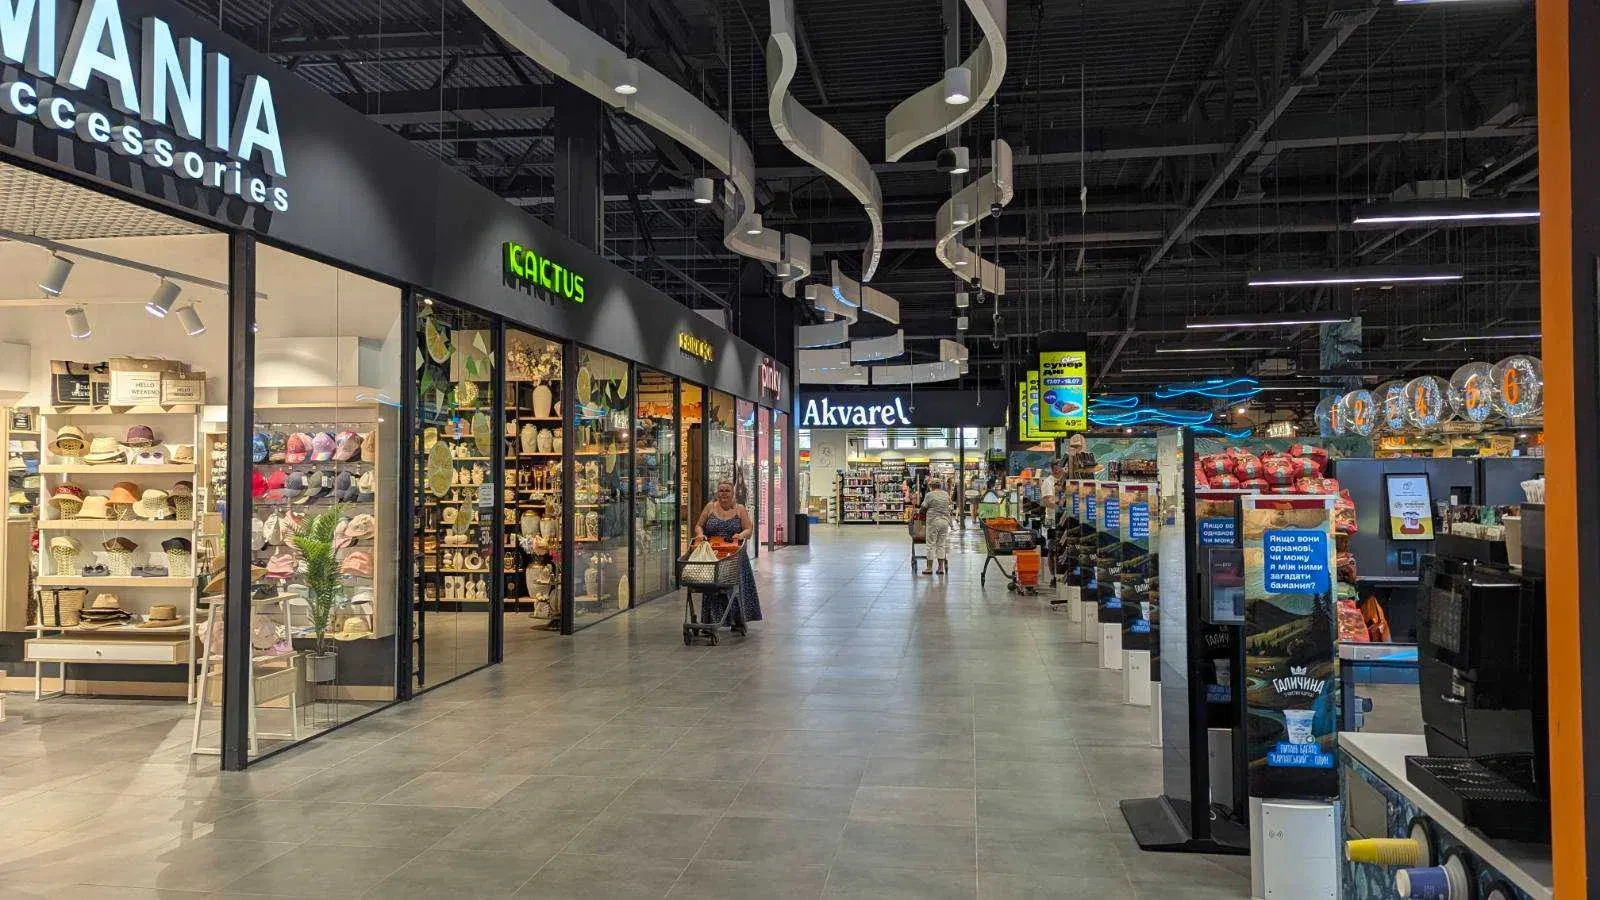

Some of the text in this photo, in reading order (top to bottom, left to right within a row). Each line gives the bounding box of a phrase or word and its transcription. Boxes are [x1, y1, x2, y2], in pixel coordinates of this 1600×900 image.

[9, 80, 290, 212] ccessories
[802, 397, 911, 426] Akvarel
[1269, 535, 1295, 544] Якщо
[1269, 545, 1314, 553] однакові,
[1283, 554, 1310, 562] можу
[1278, 563, 1296, 571] між
[1270, 573, 1311, 581] загадати
[1270, 582, 1316, 590] бажання?
[1272, 676, 1325, 694] ГАЛИЧИНА
